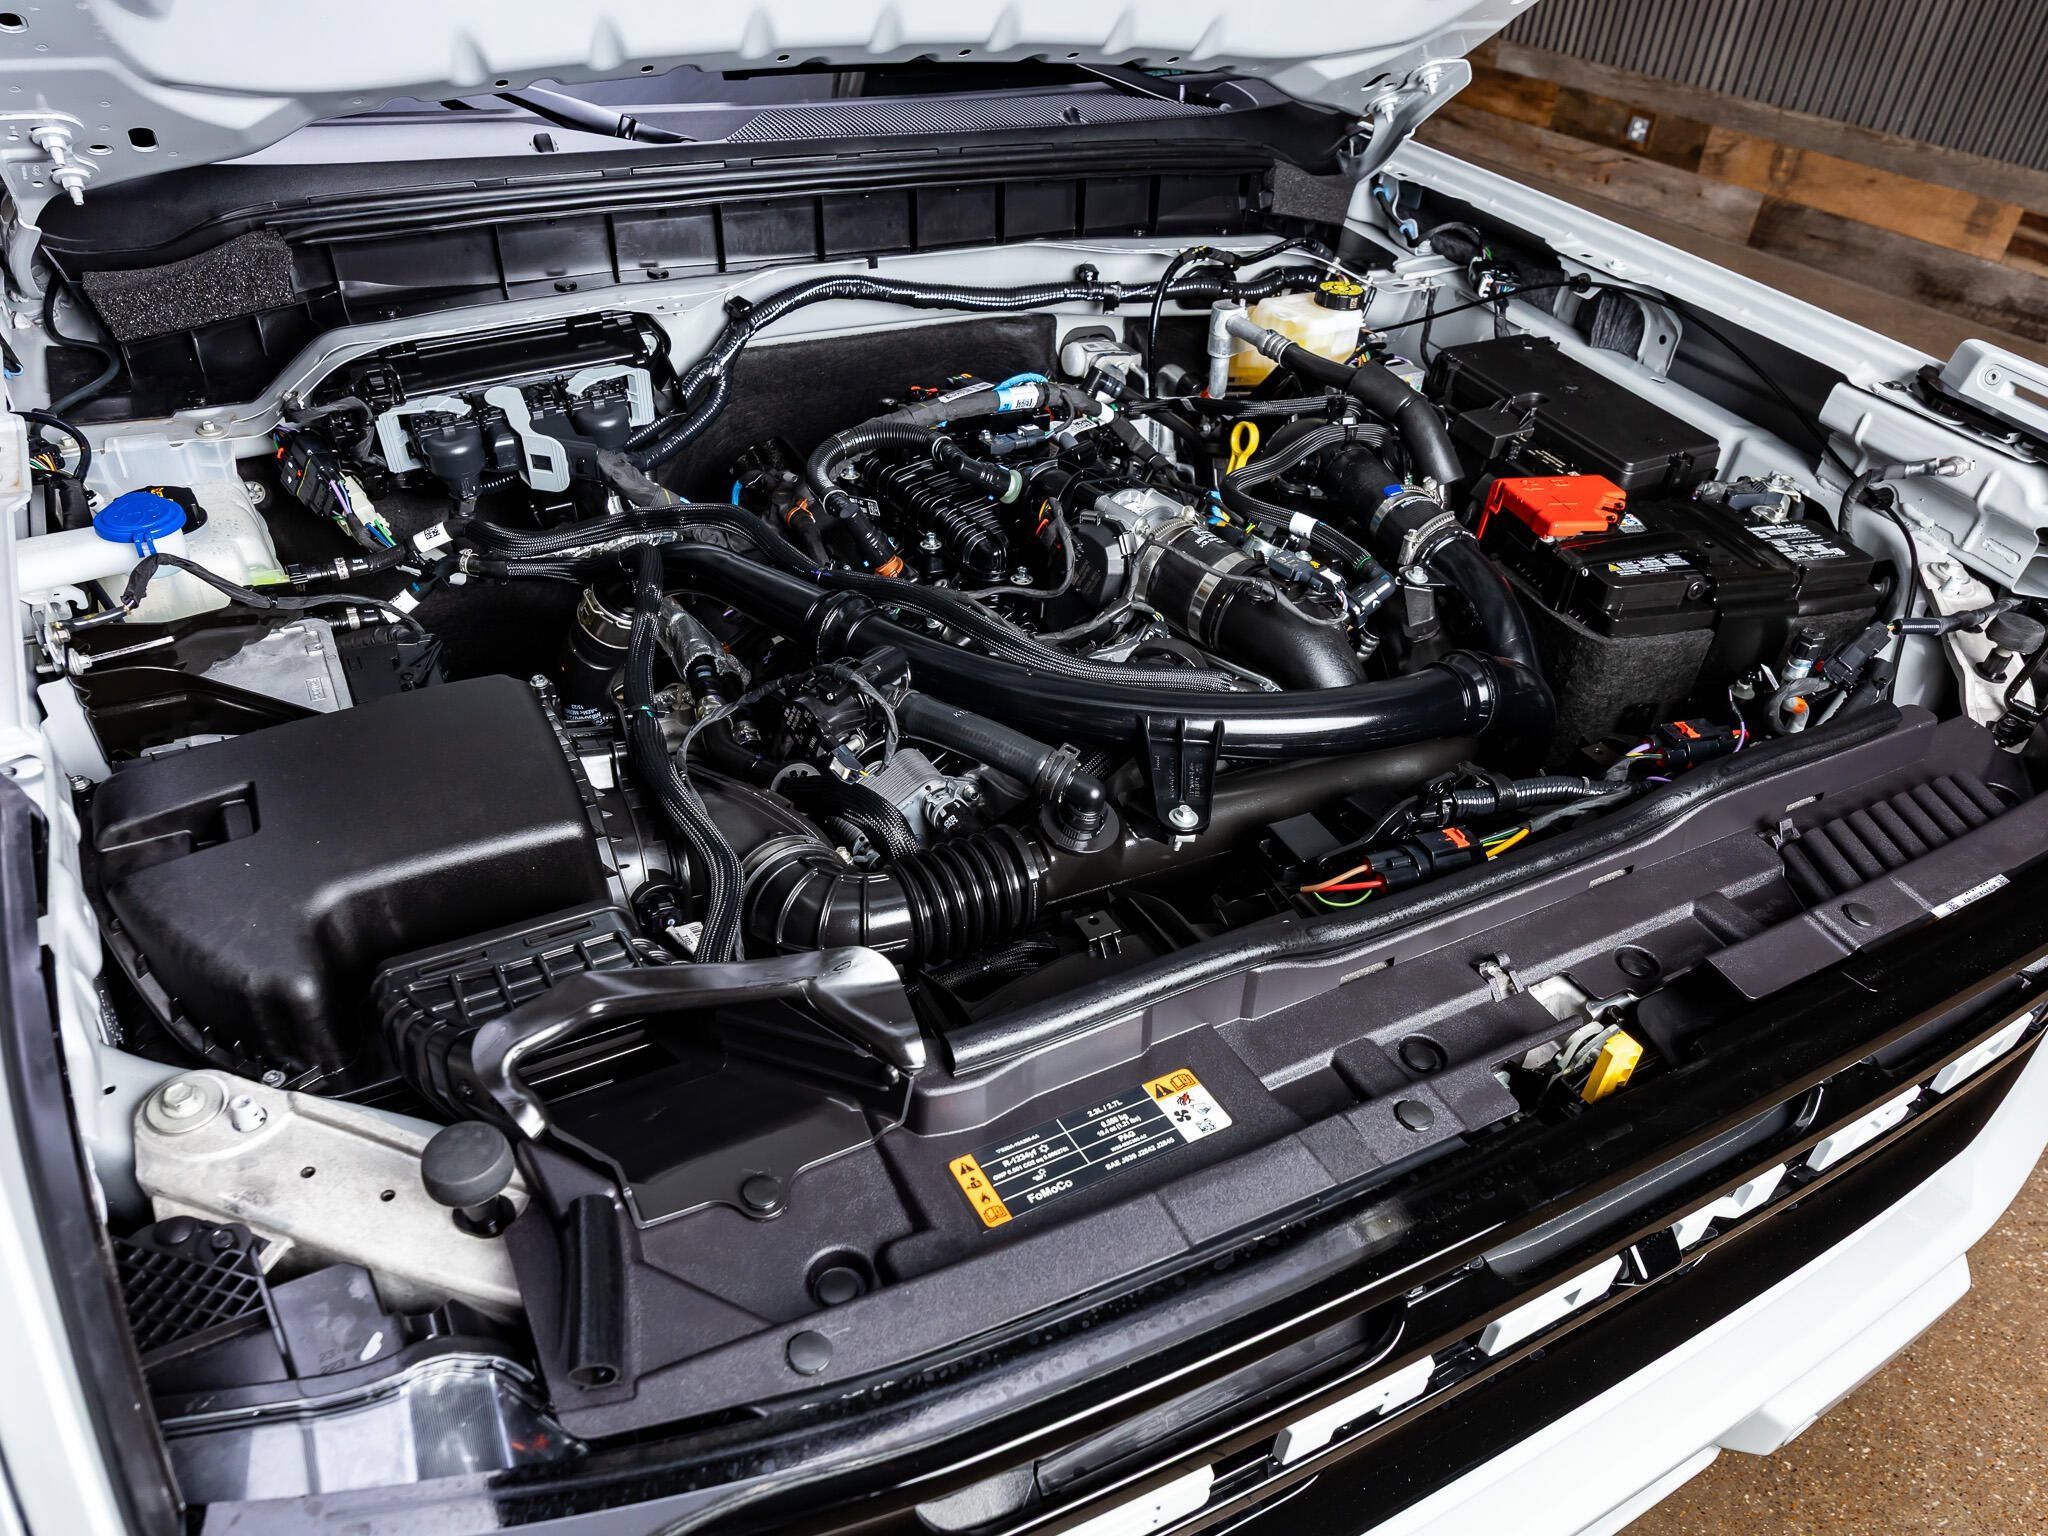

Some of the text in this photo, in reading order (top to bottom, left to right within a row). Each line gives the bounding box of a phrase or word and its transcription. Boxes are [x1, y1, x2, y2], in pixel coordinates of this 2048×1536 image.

[1086, 1106, 1104, 1118] 2.3L
[1106, 1099, 1123, 1110] 2.7L
[1117, 1130, 1136, 1142] PAG
[1001, 1148, 1037, 1168] R-1234yf
[1104, 1159, 1122, 1171] SAE
[1026, 1179, 1074, 1204] FoMoCo
